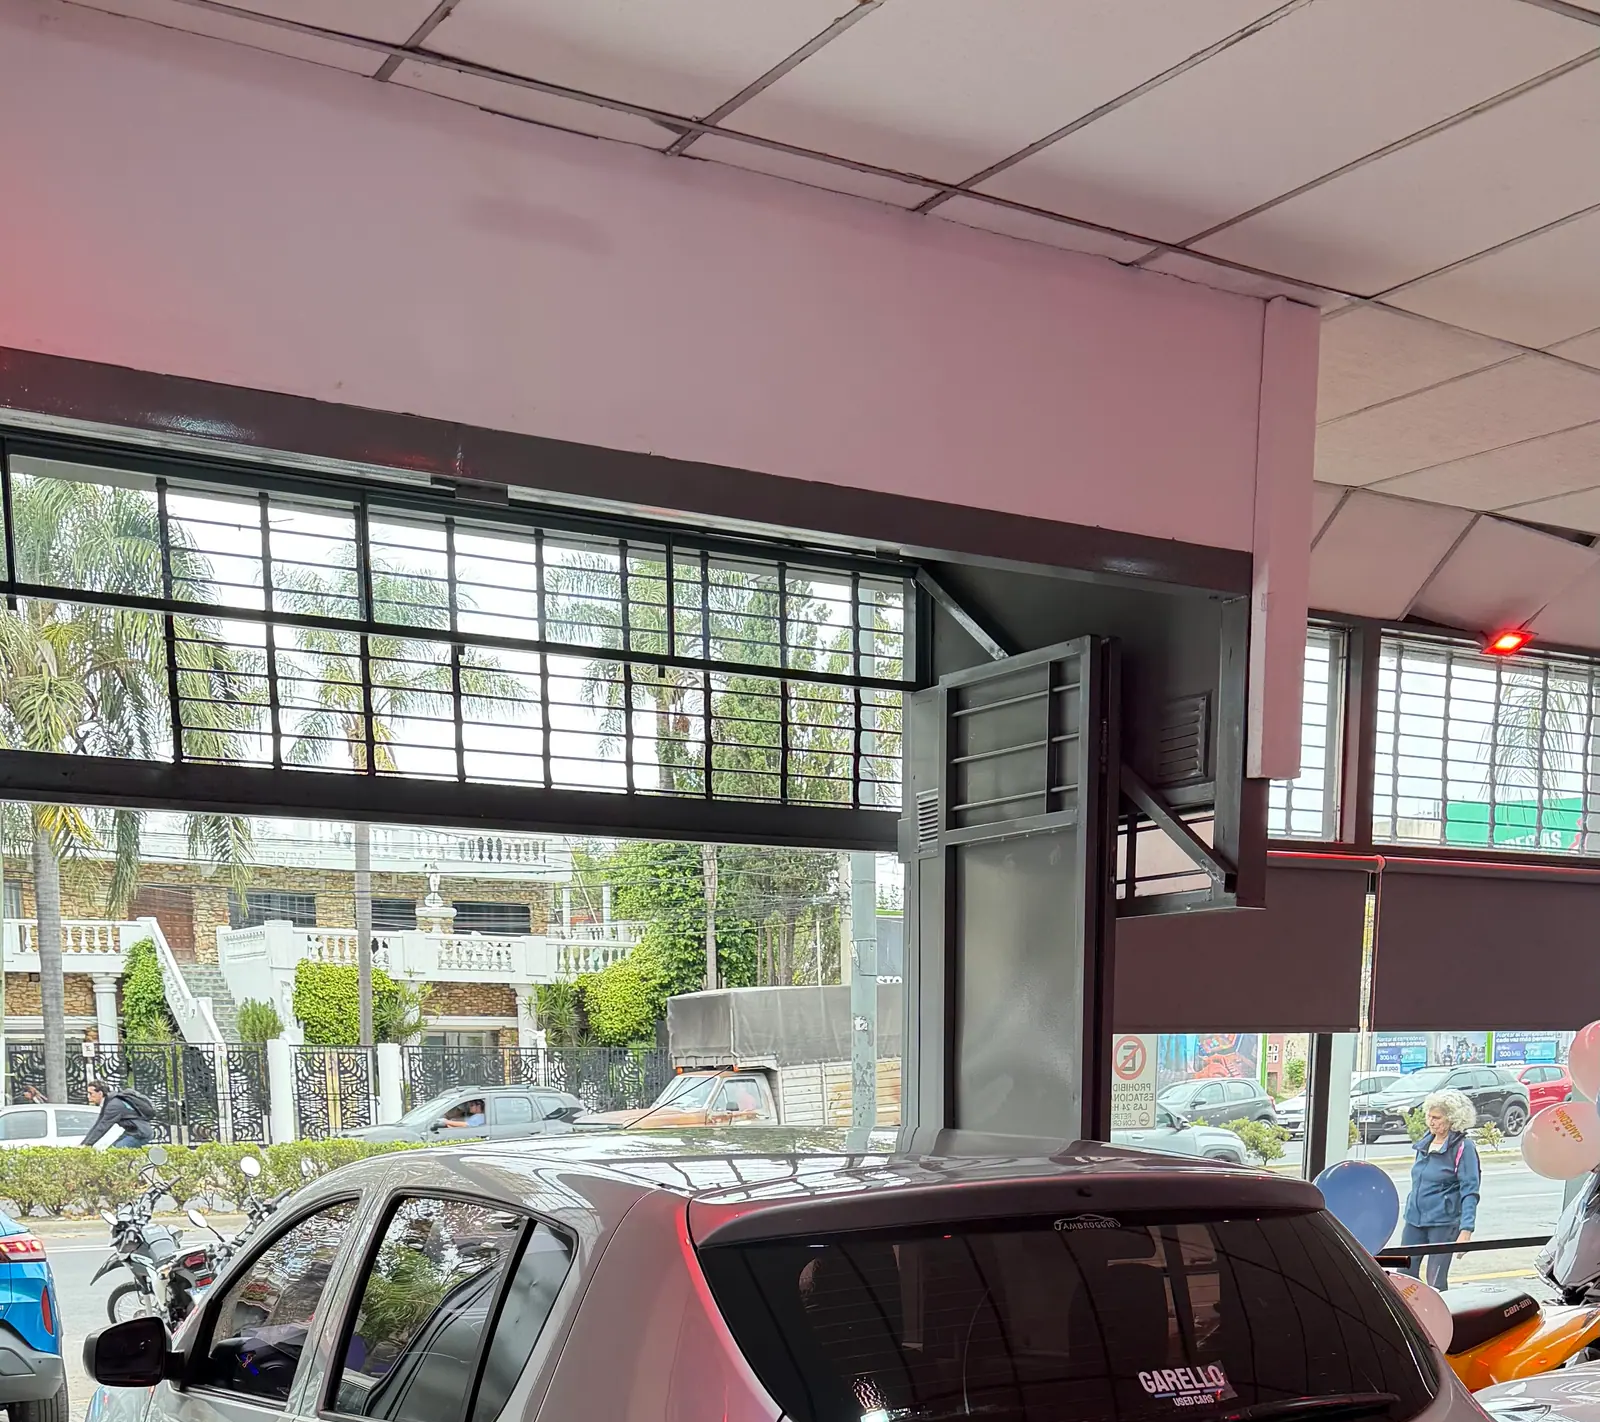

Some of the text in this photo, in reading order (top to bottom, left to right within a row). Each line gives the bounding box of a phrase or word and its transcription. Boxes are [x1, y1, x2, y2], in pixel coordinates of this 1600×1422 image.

[1138, 1365, 1225, 1394] GARELLO
[1172, 1394, 1215, 1406] USED CARS
